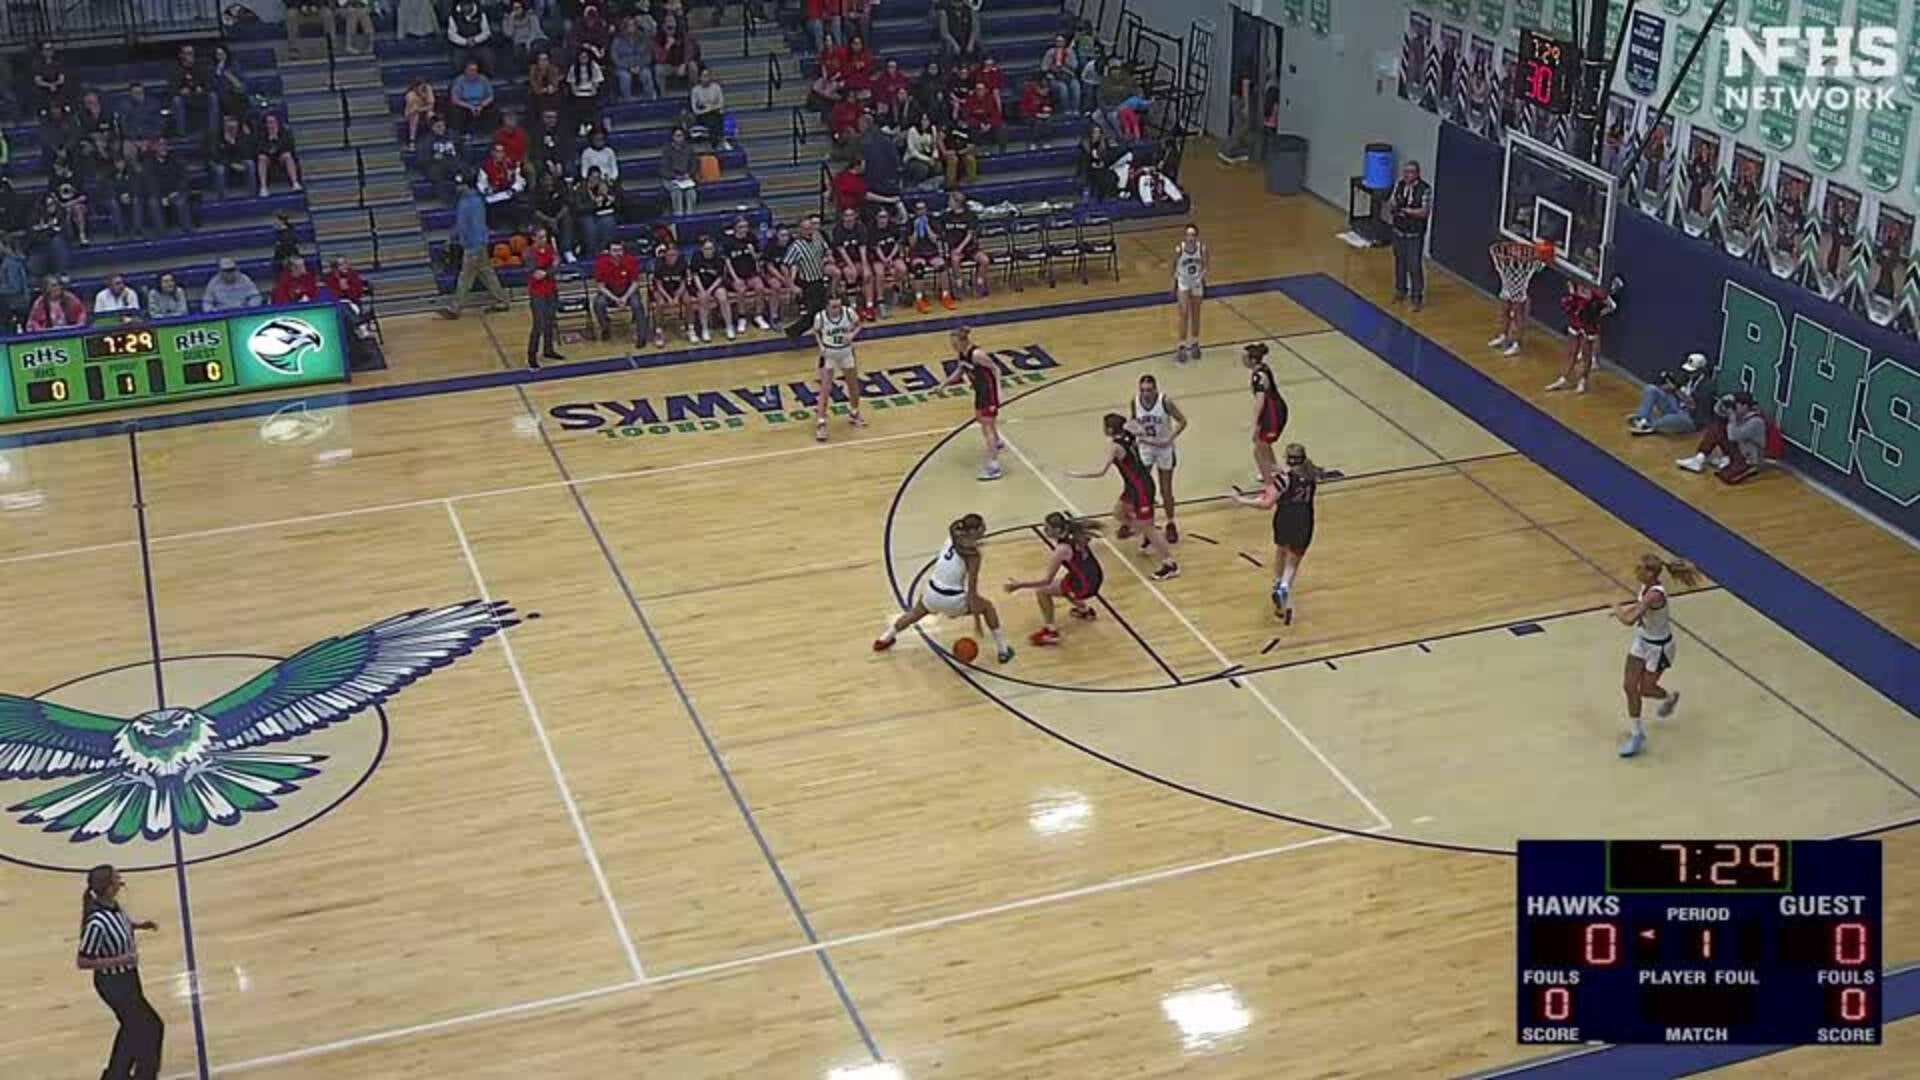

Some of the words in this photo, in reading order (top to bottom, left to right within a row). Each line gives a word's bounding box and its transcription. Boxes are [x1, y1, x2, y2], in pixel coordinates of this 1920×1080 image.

[1525, 60, 1553, 105] 30
[104, 331, 153, 353] 7:29
[175, 327, 223, 352] RHS
[22, 347, 69, 370] RHS
[206, 361, 222, 382] 0
[51, 381, 66, 401] 0
[125, 376, 134, 392] 1
[1713, 279, 1920, 507] RHS
